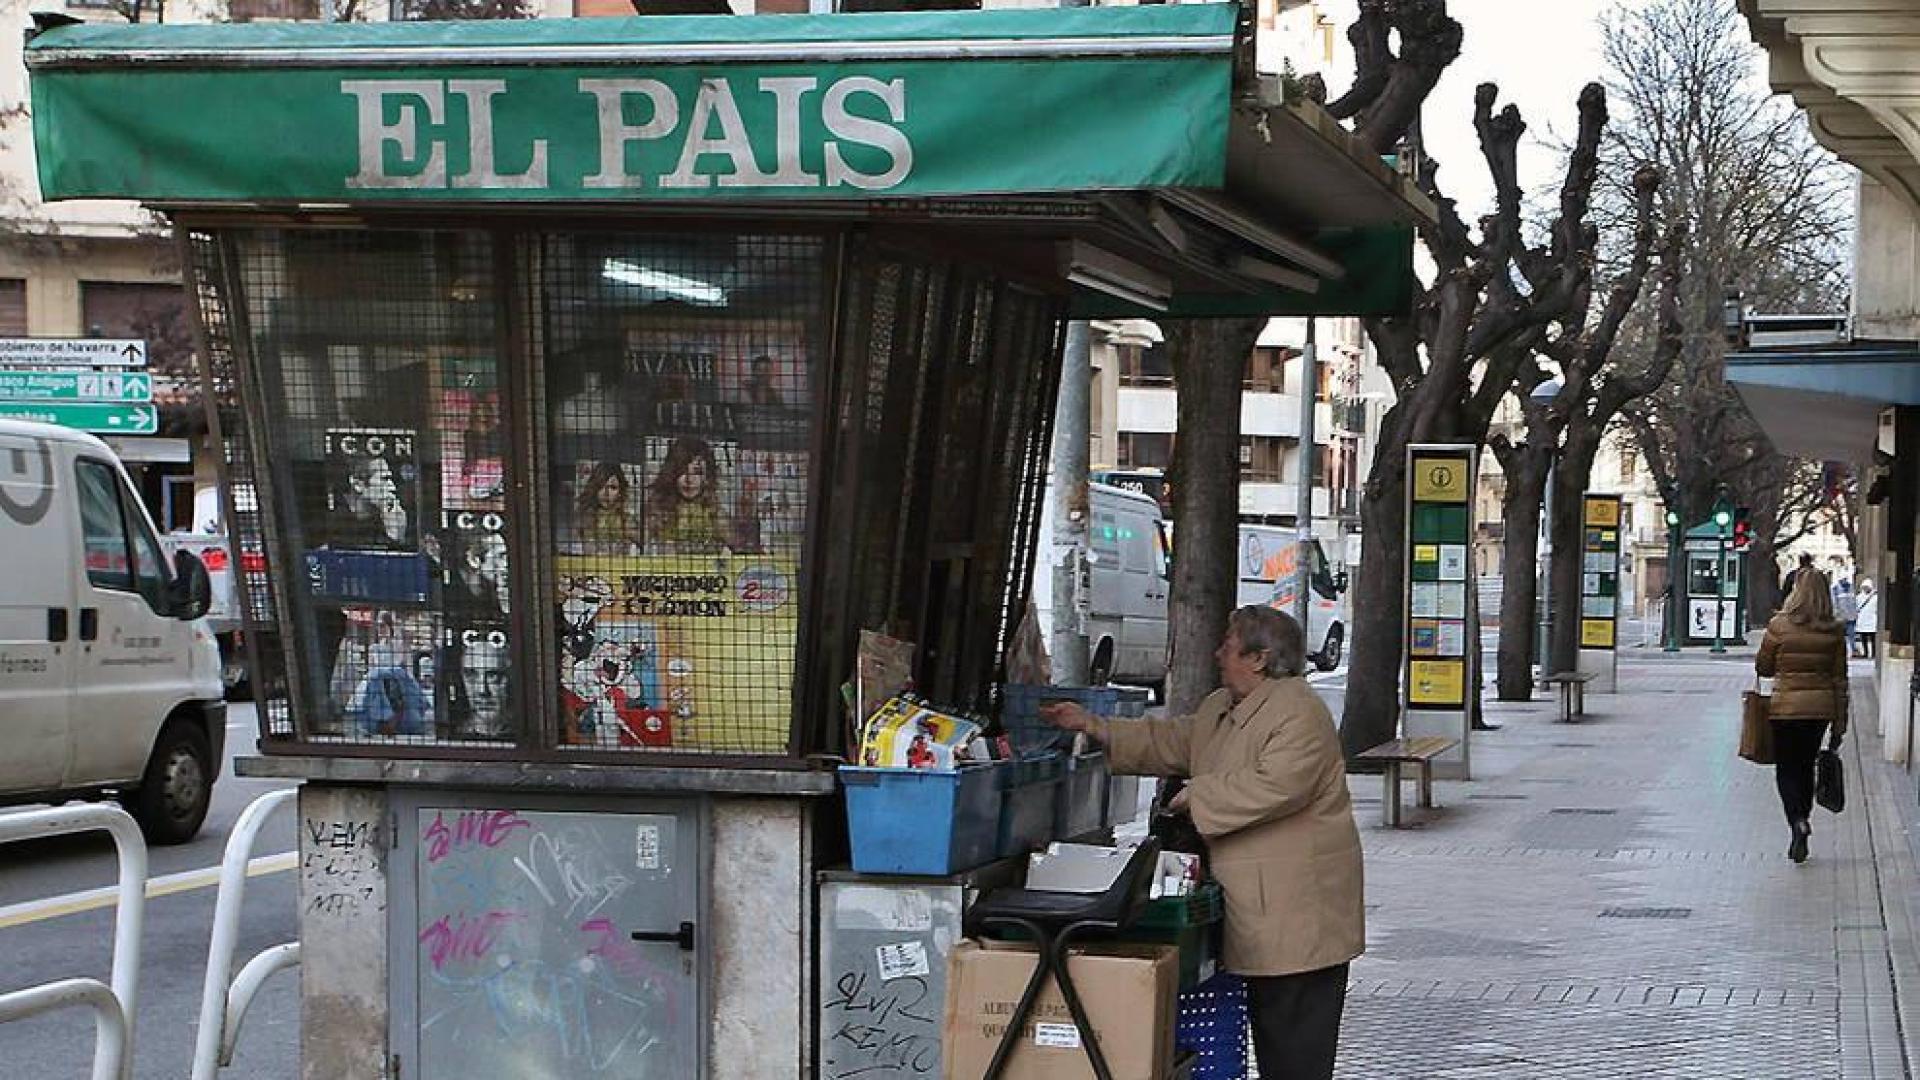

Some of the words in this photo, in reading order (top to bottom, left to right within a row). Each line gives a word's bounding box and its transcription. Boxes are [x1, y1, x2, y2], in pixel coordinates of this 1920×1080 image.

[340, 78, 549, 190] EL
[577, 76, 914, 190] PAIS
[441, 511, 504, 530] ICO
[446, 628, 507, 648] ICO
